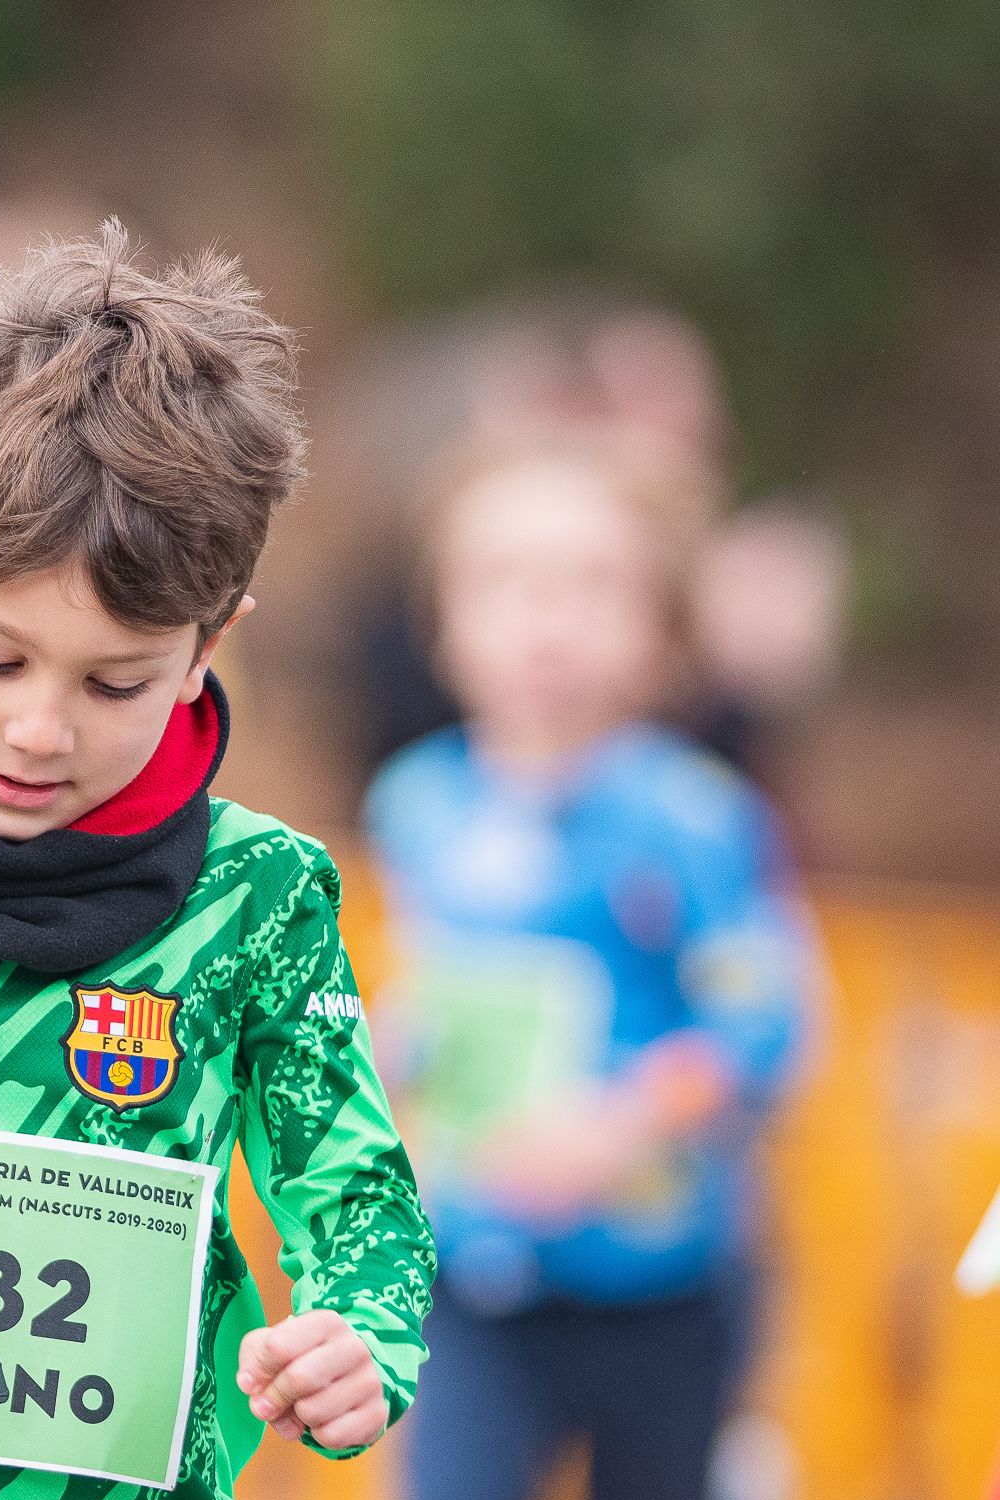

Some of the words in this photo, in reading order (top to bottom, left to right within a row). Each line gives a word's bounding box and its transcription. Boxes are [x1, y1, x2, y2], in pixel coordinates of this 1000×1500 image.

[101, 1036, 144, 1054] FCB
[40, 1167, 71, 1188] DE
[78, 1173, 195, 1210] VALLDOREIX
[18, 1196, 102, 1222] (NASCUTS
[106, 1209, 187, 1241] 2019-2020)
